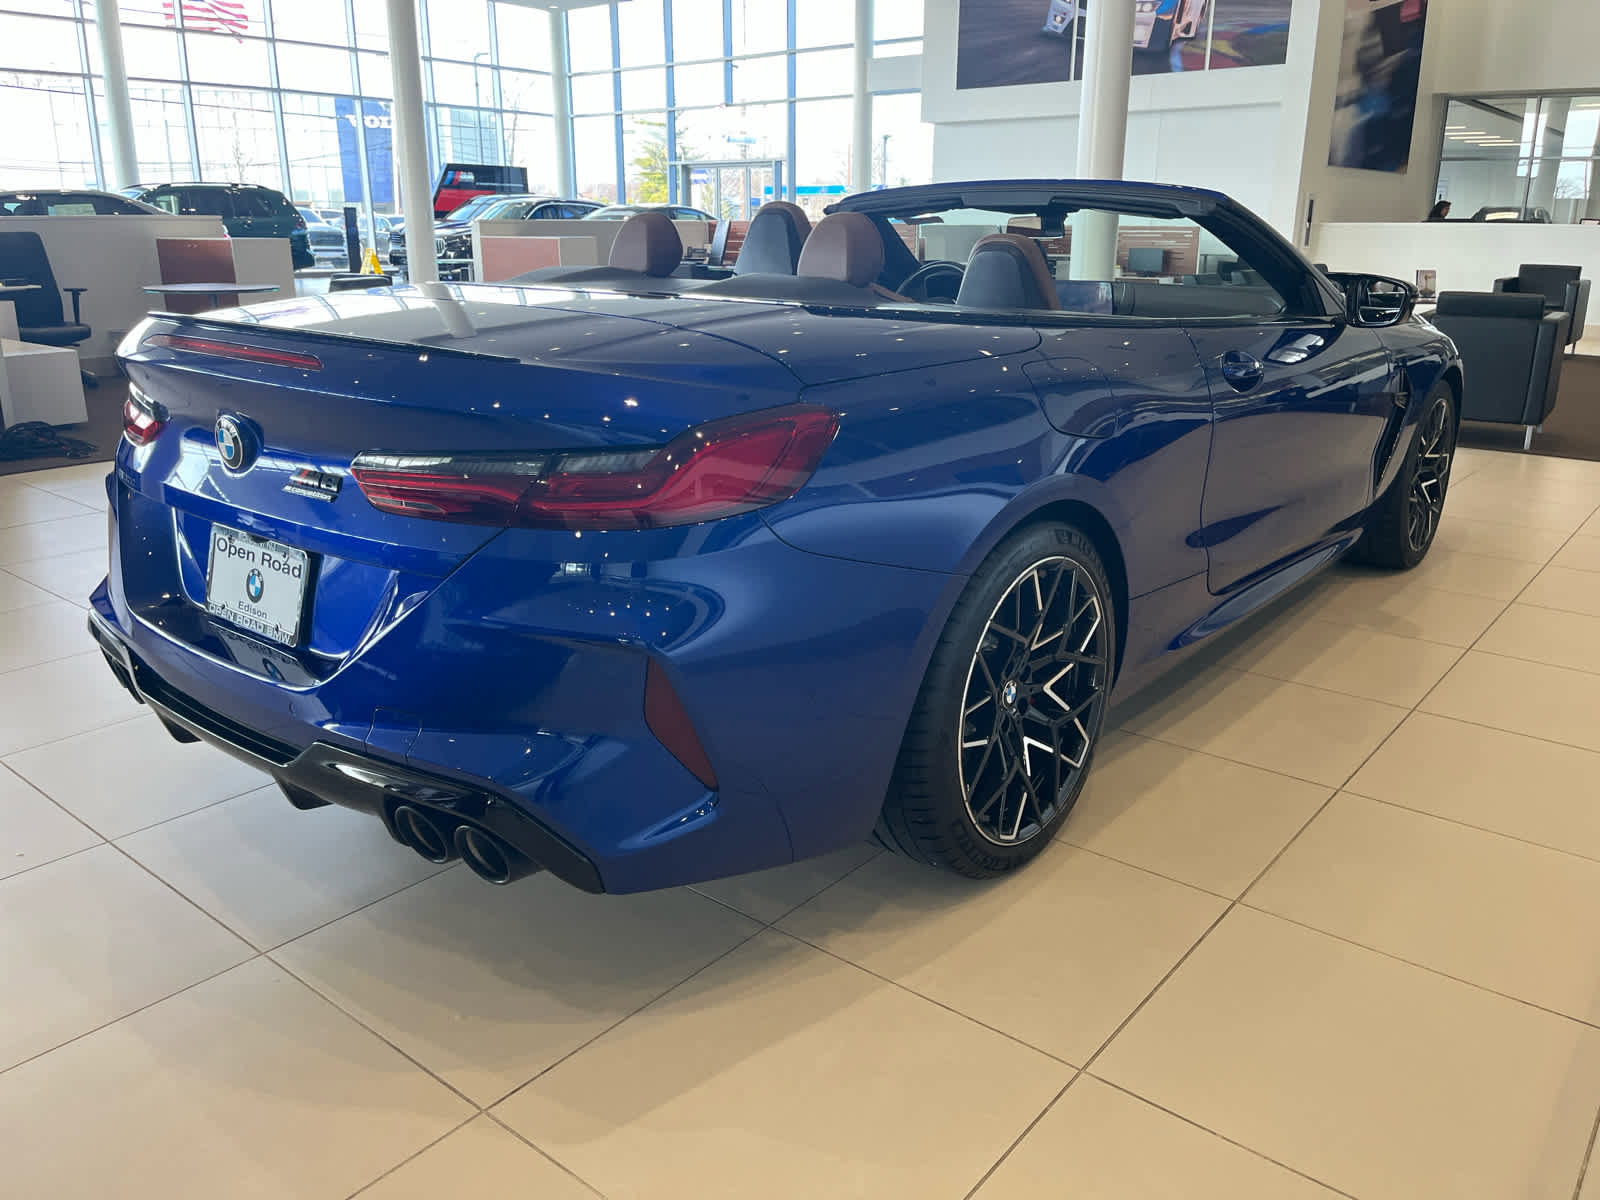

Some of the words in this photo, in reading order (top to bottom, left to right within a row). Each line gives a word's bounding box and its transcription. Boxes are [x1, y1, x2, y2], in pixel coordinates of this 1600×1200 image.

[216, 537, 256, 562] Open
[260, 551, 302, 579] Road
[238, 601, 268, 619] Edison
[236, 615, 264, 632] ROAD
